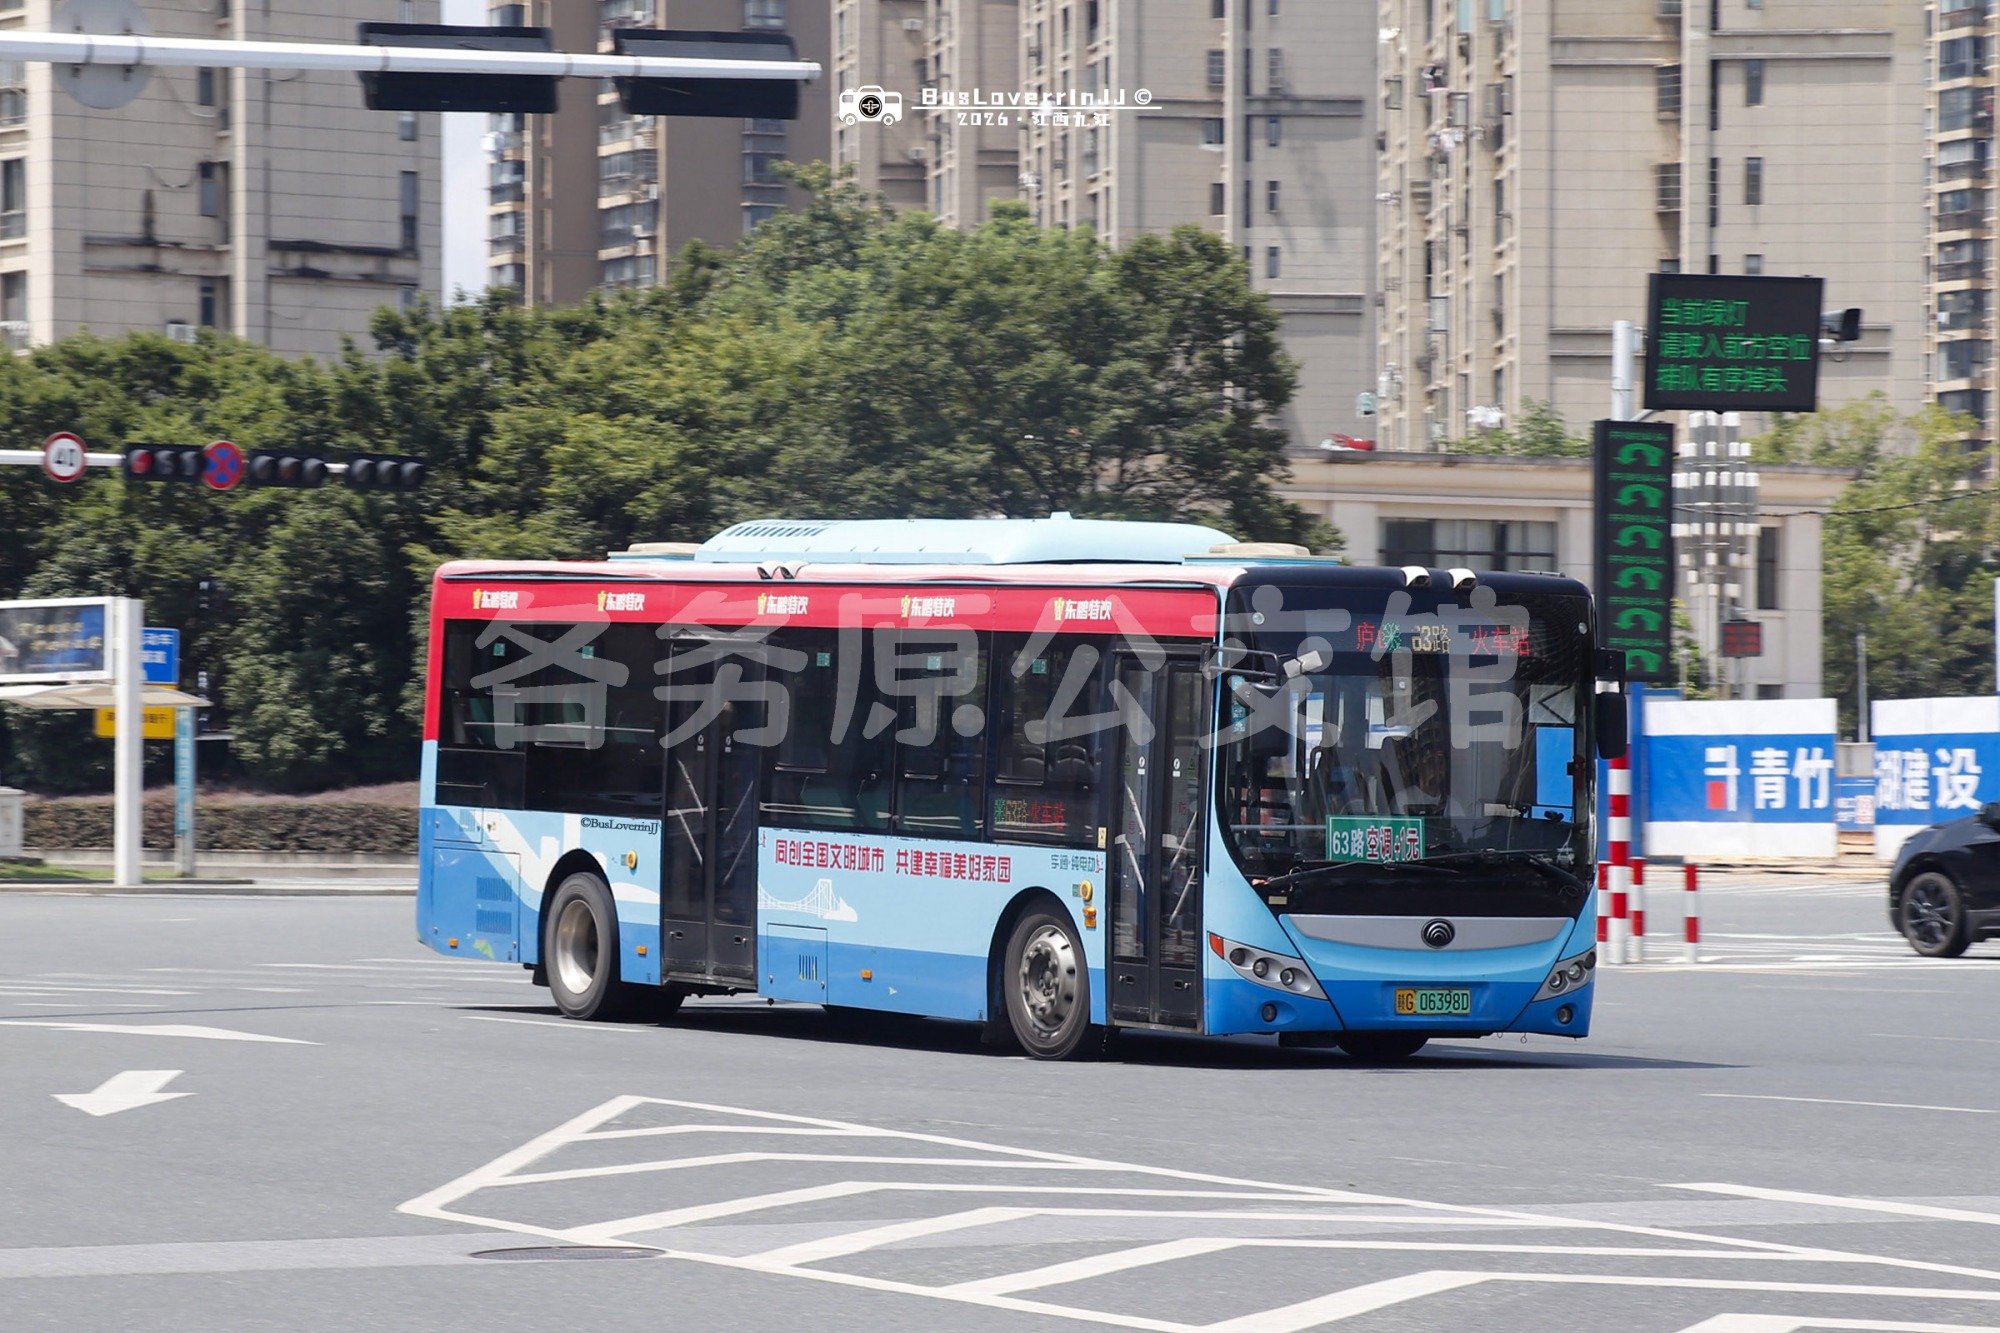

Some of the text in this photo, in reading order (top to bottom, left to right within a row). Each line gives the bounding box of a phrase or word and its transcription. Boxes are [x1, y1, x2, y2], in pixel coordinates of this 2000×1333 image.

[1660, 298, 1749, 326] 当前绿灯
[1657, 332, 1811, 359] 请驶入前方空位
[1656, 364, 1788, 392] 排队有序掉头
[480, 591, 518, 610] 东鹏特饮
[606, 592, 644, 612] 东鹏特饮
[767, 593, 809, 614] 东鹏特饮
[910, 597, 955, 618] 东鹏特饮
[1064, 600, 1112, 620] 东鹏特饮
[1472, 626, 1530, 656] 火车站
[775, 839, 884, 873] 同创全国文明城市
[895, 849, 1011, 883] 共建幸福美好家园
